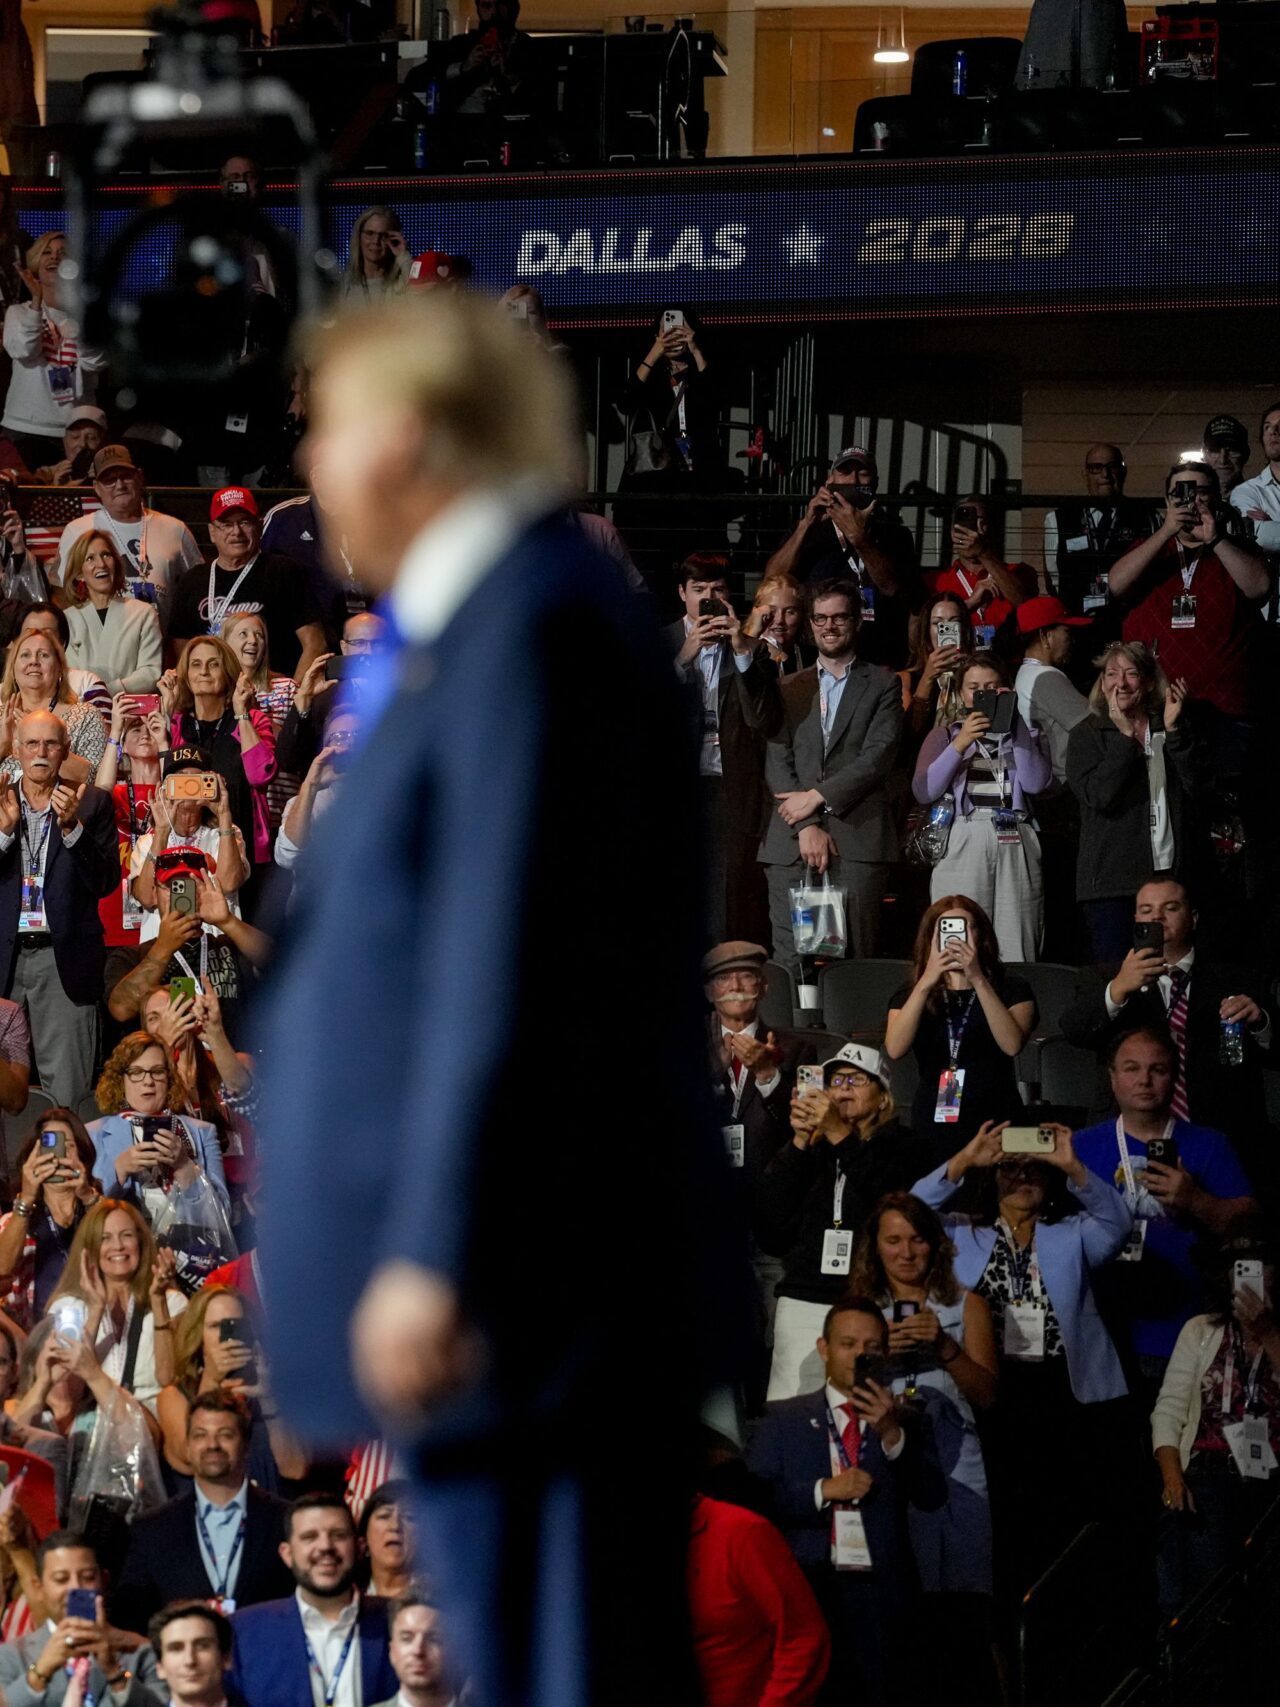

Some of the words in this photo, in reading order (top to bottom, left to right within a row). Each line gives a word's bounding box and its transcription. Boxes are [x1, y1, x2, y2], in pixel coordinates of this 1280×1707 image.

[517, 223, 747, 276] DALLAS
[859, 211, 1075, 265] 2026
[172, 748, 203, 762] USA
